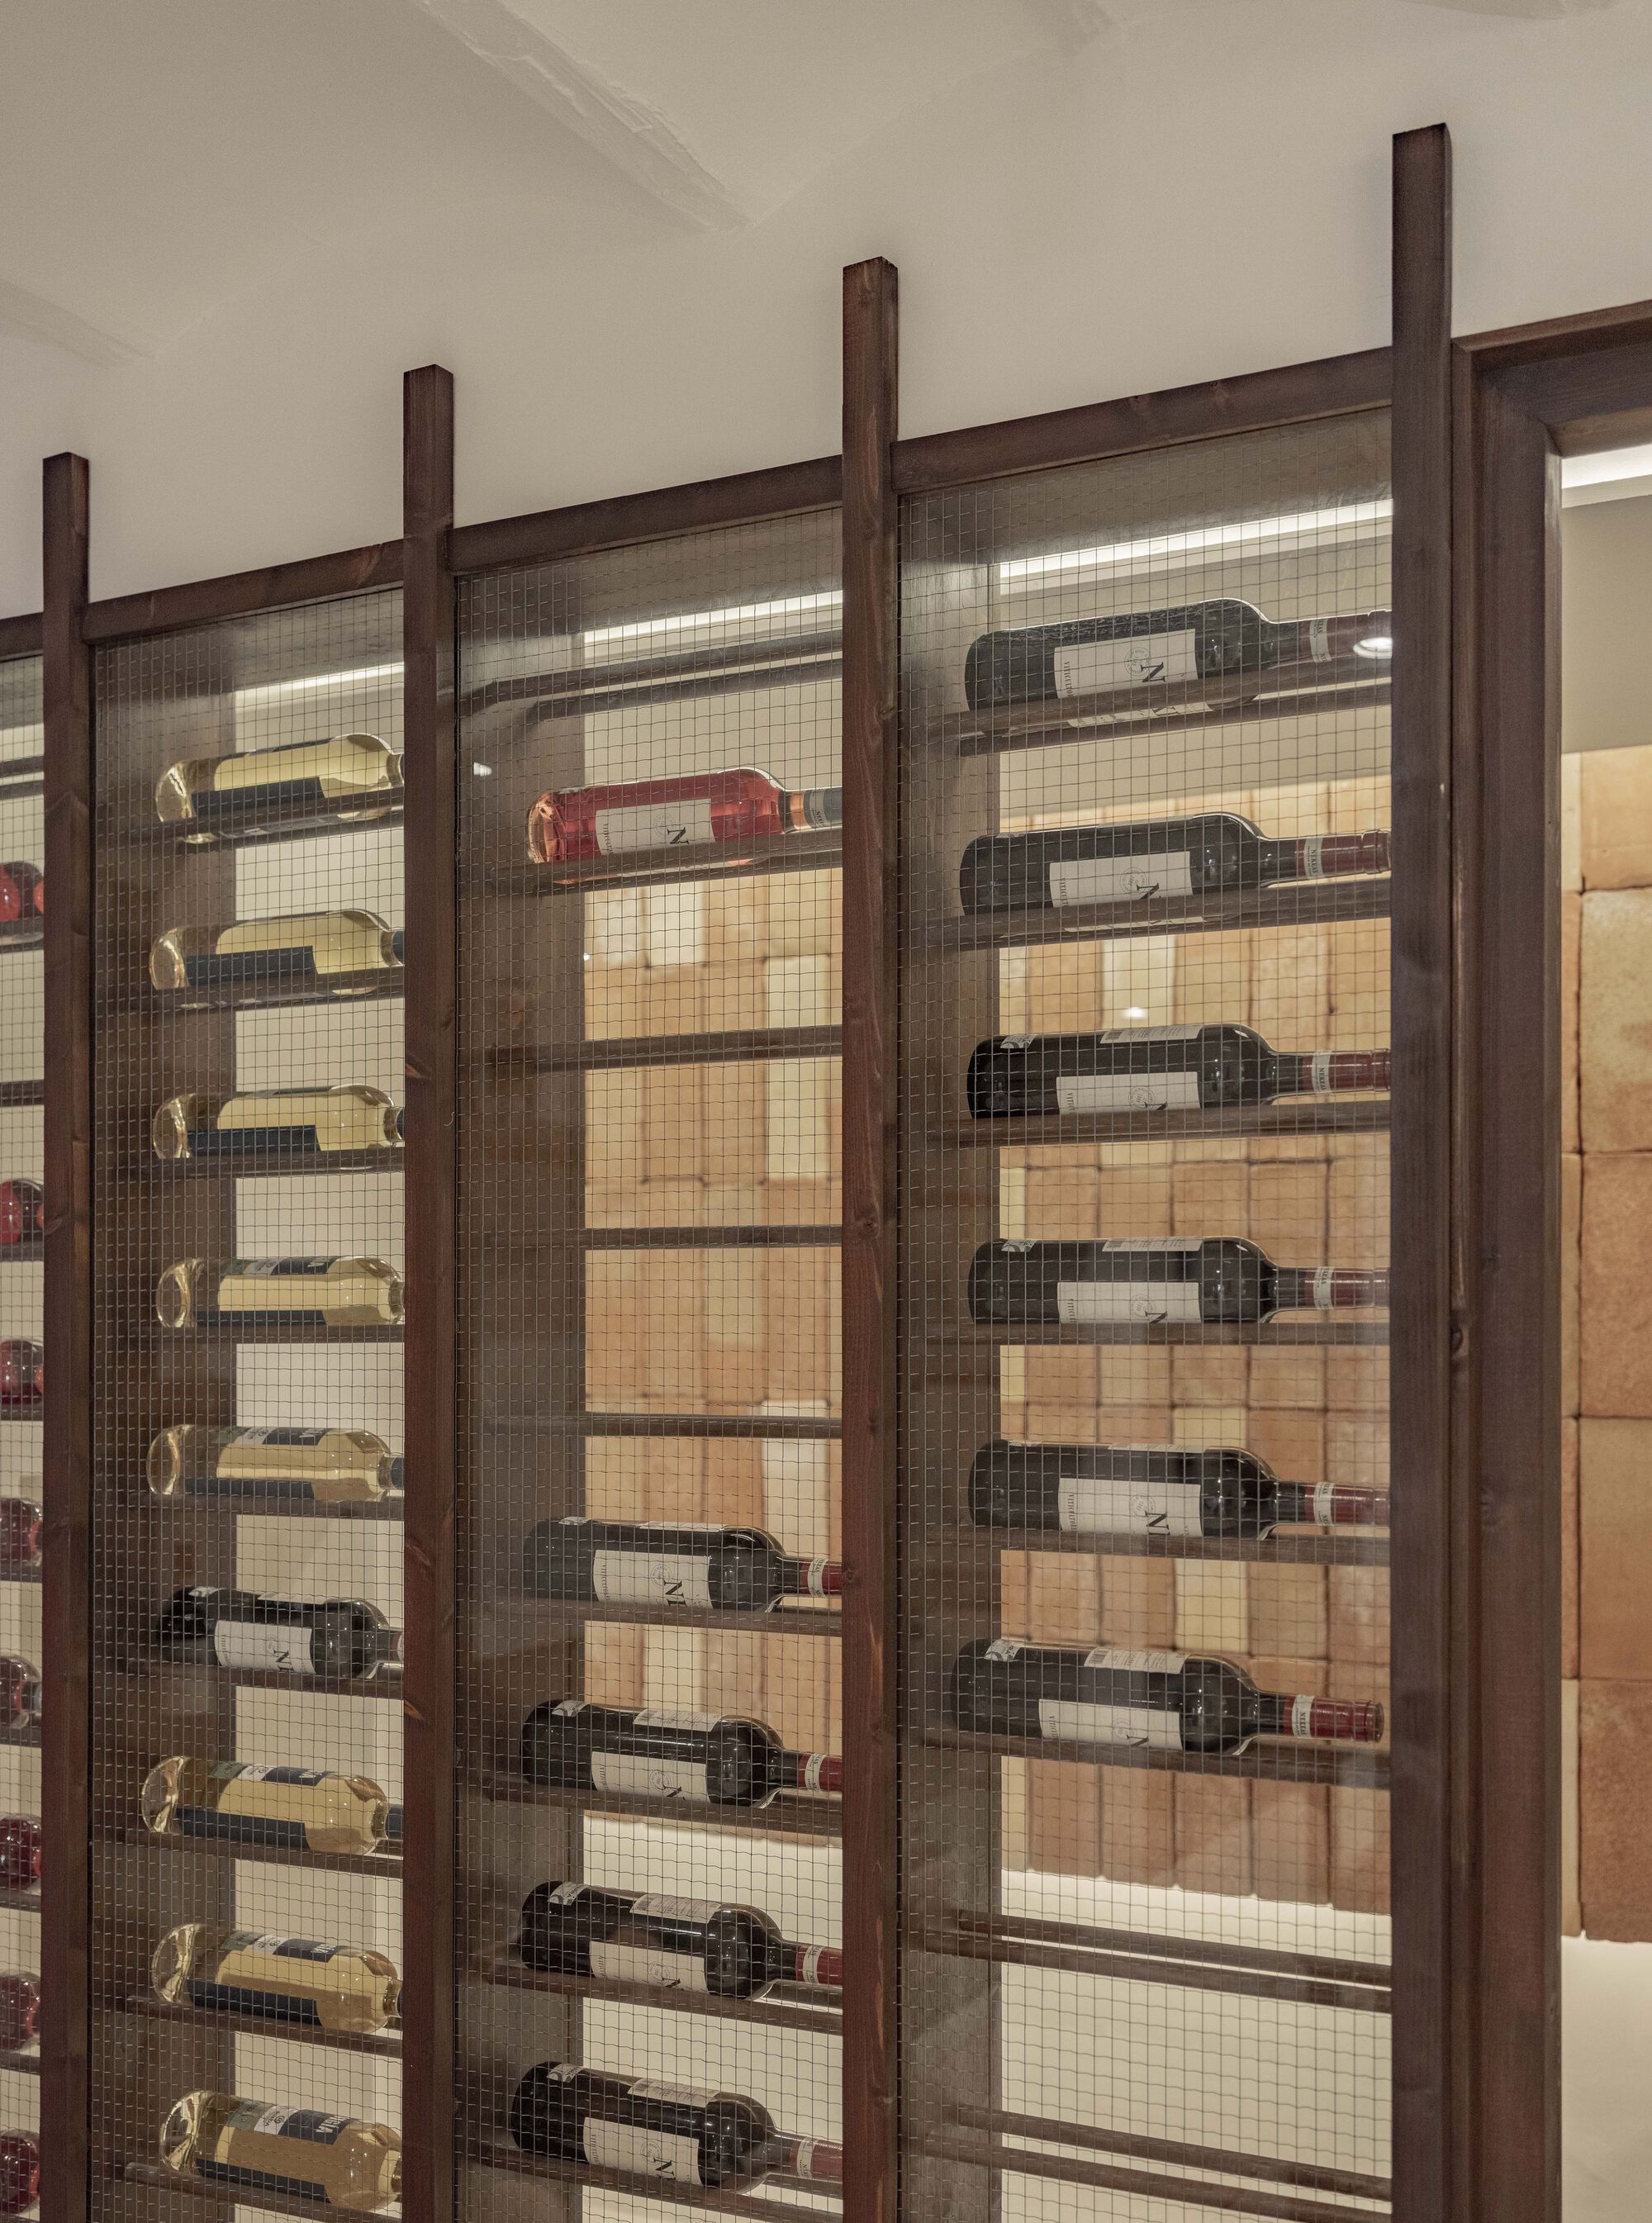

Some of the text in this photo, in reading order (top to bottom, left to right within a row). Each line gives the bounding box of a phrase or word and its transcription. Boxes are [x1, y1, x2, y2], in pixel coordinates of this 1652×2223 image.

[1310, 849, 1319, 874] NEKEAS
[1318, 1067, 1327, 1090] NEKEAS
[1299, 1712, 1308, 1736] NEKEAS
